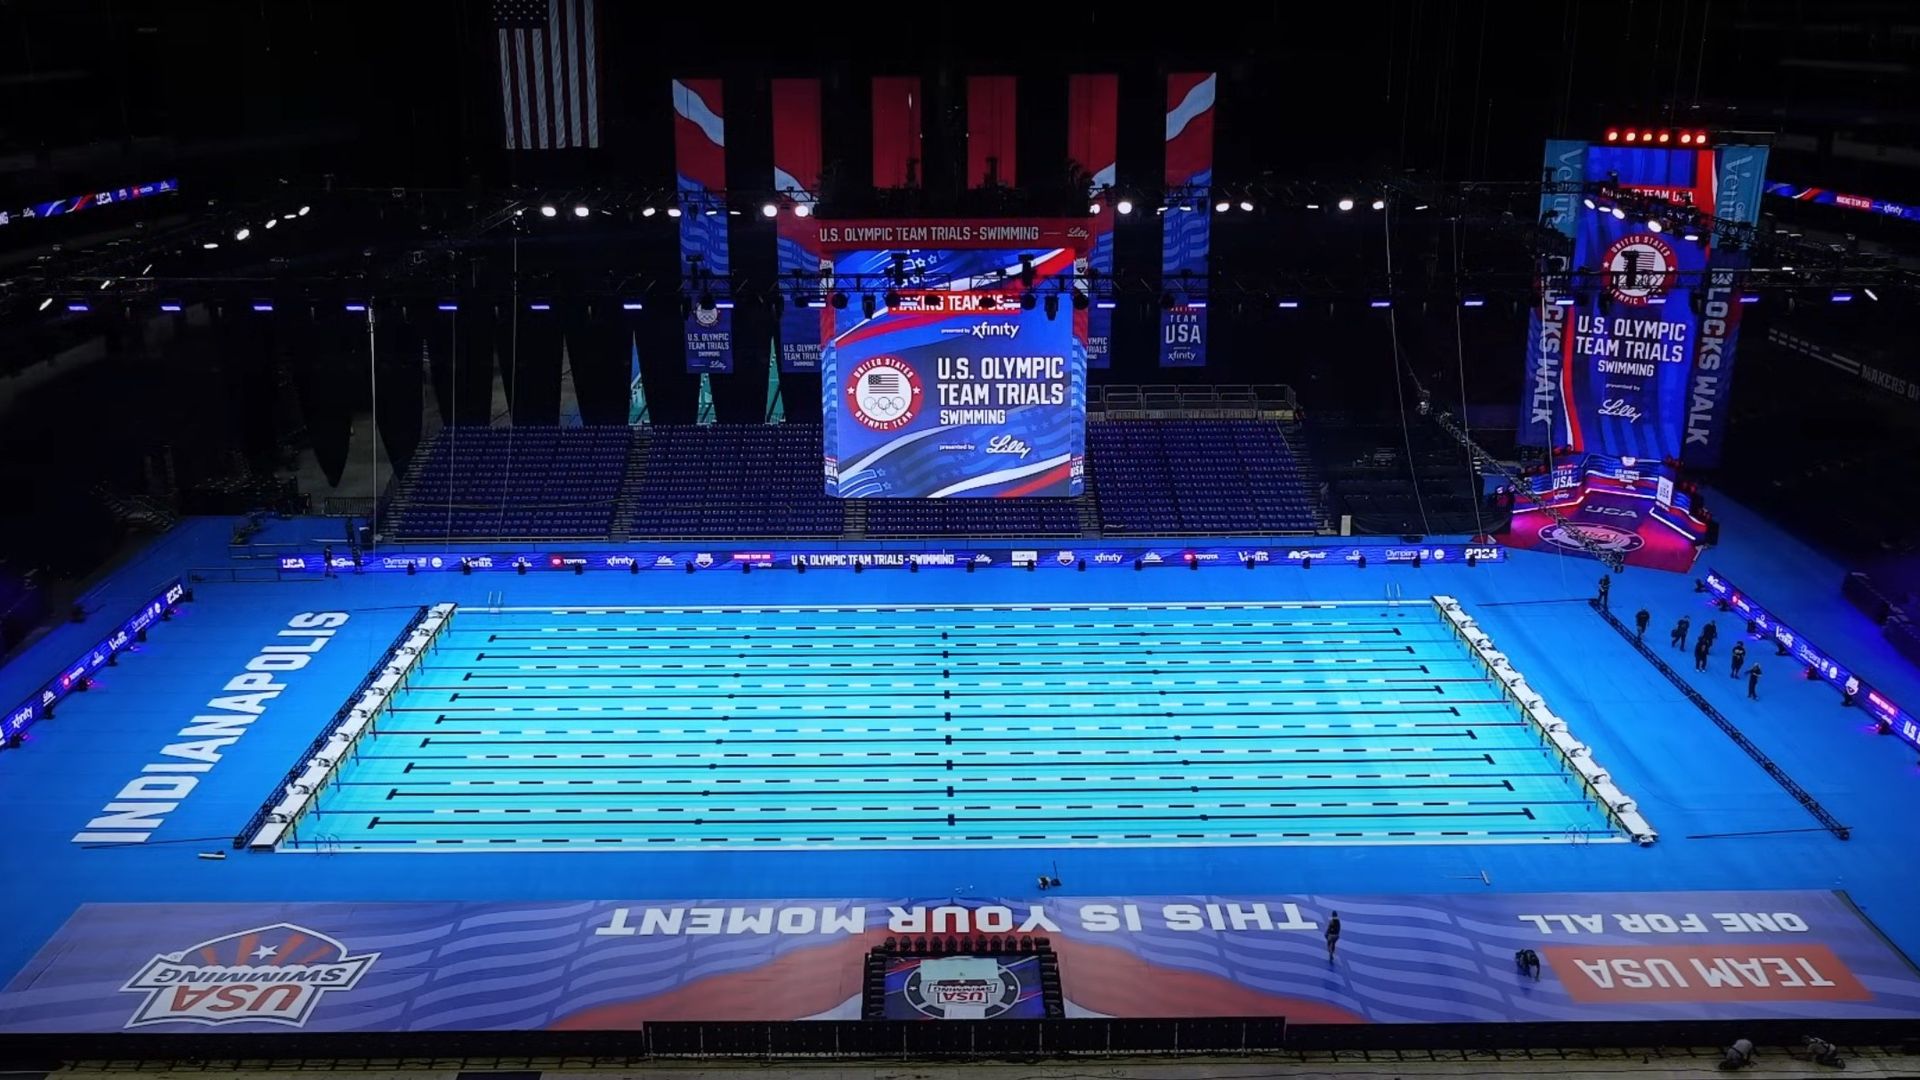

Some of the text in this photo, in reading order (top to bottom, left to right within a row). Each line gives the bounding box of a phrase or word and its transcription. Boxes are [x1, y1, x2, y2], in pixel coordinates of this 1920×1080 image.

[1552, 149, 1583, 224] Veus
[1718, 155, 1753, 224] Venu
[95, 192, 112, 205] USA
[820, 228, 841, 242] U.S.
[844, 227, 893, 242] OLYMPIC
[896, 227, 928, 241] TEAM
[1067, 227, 1090, 240] Lilly
[1611, 235, 1671, 256] UNITED STATES
[948, 295, 981, 311] TEAM
[1170, 315, 1197, 323] TEAM
[972, 321, 1019, 339] xfinity
[1166, 324, 1201, 344] USA
[1578, 315, 1686, 342] U.S. OLYMPIC
[688, 333, 729, 341] U.S. OLYMPIC
[1087, 337, 1108, 345] YMPIC
[688, 342, 729, 350] TEAM TRIALS
[784, 344, 795, 352] U.S.
[1576, 336, 1683, 363] TEAM TRIALS
[784, 352, 801, 360] TEAM
[1168, 351, 1196, 361] xfinity
[709, 360, 727, 369] Lilly
[853, 358, 914, 378] UNITED STATES
[937, 357, 1063, 380] U.S. OLYMPIC
[1598, 360, 1654, 377] SWIMMING
[1862, 364, 1907, 395] MAKERS
[937, 383, 1063, 405] TEAM TRIALS
[1532, 359, 1559, 425] WALK
[940, 409, 1006, 425] SWIMMING
[1598, 399, 1642, 423] Lilly
[1686, 376, 1718, 445] WALK
[855, 410, 913, 430] OLYMPIC TEAM
[985, 435, 1031, 458] Lilly
[1553, 476, 1573, 489] USA
[1585, 505, 1638, 518] USA
[283, 558, 305, 568] USA
[606, 556, 634, 566] xfinity
[791, 554, 808, 565] US.
[810, 554, 846, 565] OLYMPIC
[848, 554, 872, 565] TEAM
[1094, 553, 1123, 563] xfinity
[70, 611, 350, 842] INDIANAPOLIS
[595, 903, 1318, 936] THIS IS YOUR MOMENT
[1518, 912, 1809, 935] ONE FOR ALL
[154, 967, 347, 983] SWIMMING
[1573, 957, 1836, 989] TEAM USA
[933, 983, 993, 992] SWIMMING
[170, 984, 303, 1012] USA
[943, 992, 983, 1001] USA
